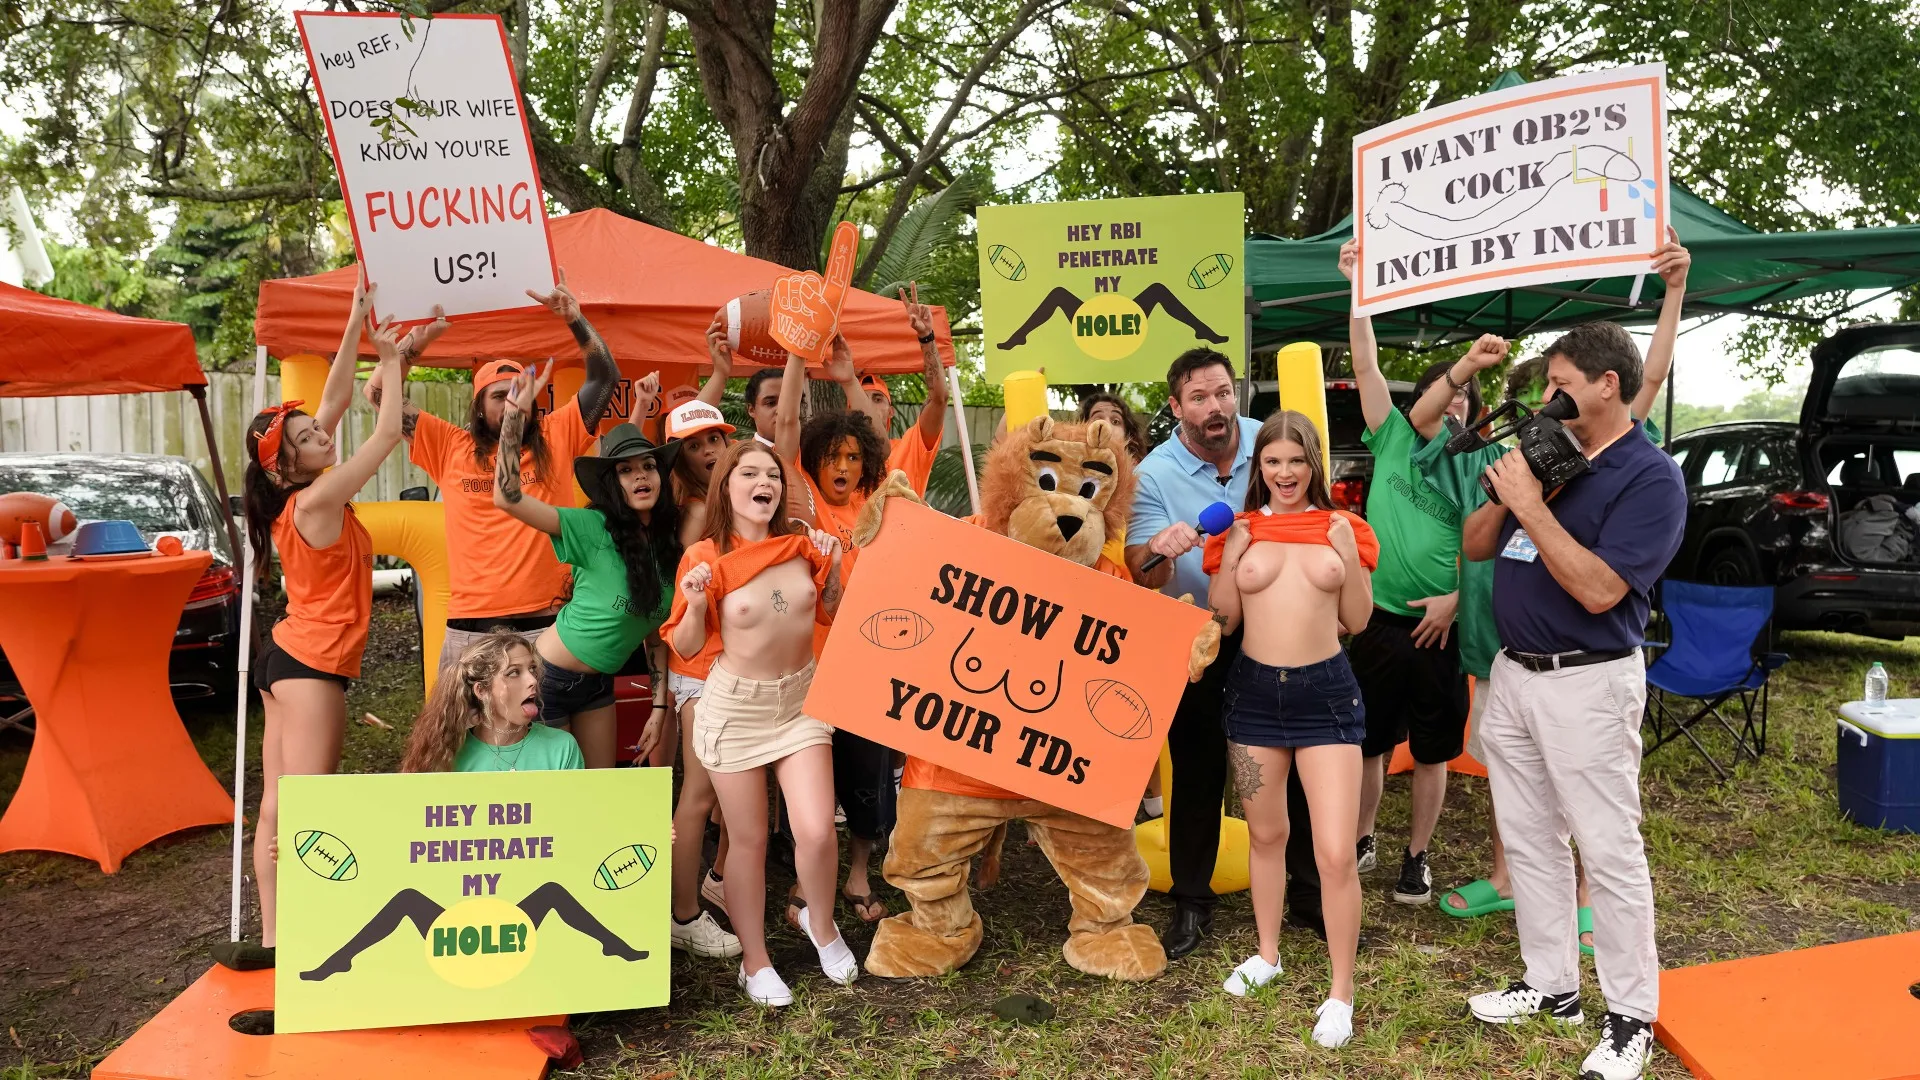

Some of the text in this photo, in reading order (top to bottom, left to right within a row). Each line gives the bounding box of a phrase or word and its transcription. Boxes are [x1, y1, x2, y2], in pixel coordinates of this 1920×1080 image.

[320, 33, 400, 70] hey REF,
[330, 100, 392, 119] DOES
[466, 99, 516, 118] WIFE
[360, 139, 511, 162] KNOW YOU'RE
[1381, 102, 1627, 182] I WANT QB2'S
[1445, 161, 1546, 204] COCK
[365, 182, 532, 233] FUCKING
[1067, 222, 1141, 242] HEY RBI
[434, 251, 497, 284] US?!
[1058, 247, 1158, 269] PENETRATE
[1376, 217, 1636, 287] INCH BY INCH
[1094, 275, 1122, 293] MY
[777, 312, 821, 350] WE'RE
[1076, 313, 1141, 337] HOLE!
[680, 408, 719, 423] LIONS
[1386, 471, 1456, 527] FOOTBALL
[930, 563, 1128, 665] SHOW US
[885, 678, 1091, 785] YOUR TDs
[425, 803, 532, 828] HEY RBI
[410, 836, 554, 863] PENETRATE
[462, 873, 501, 896] MY
[433, 923, 527, 957] HOLE!
